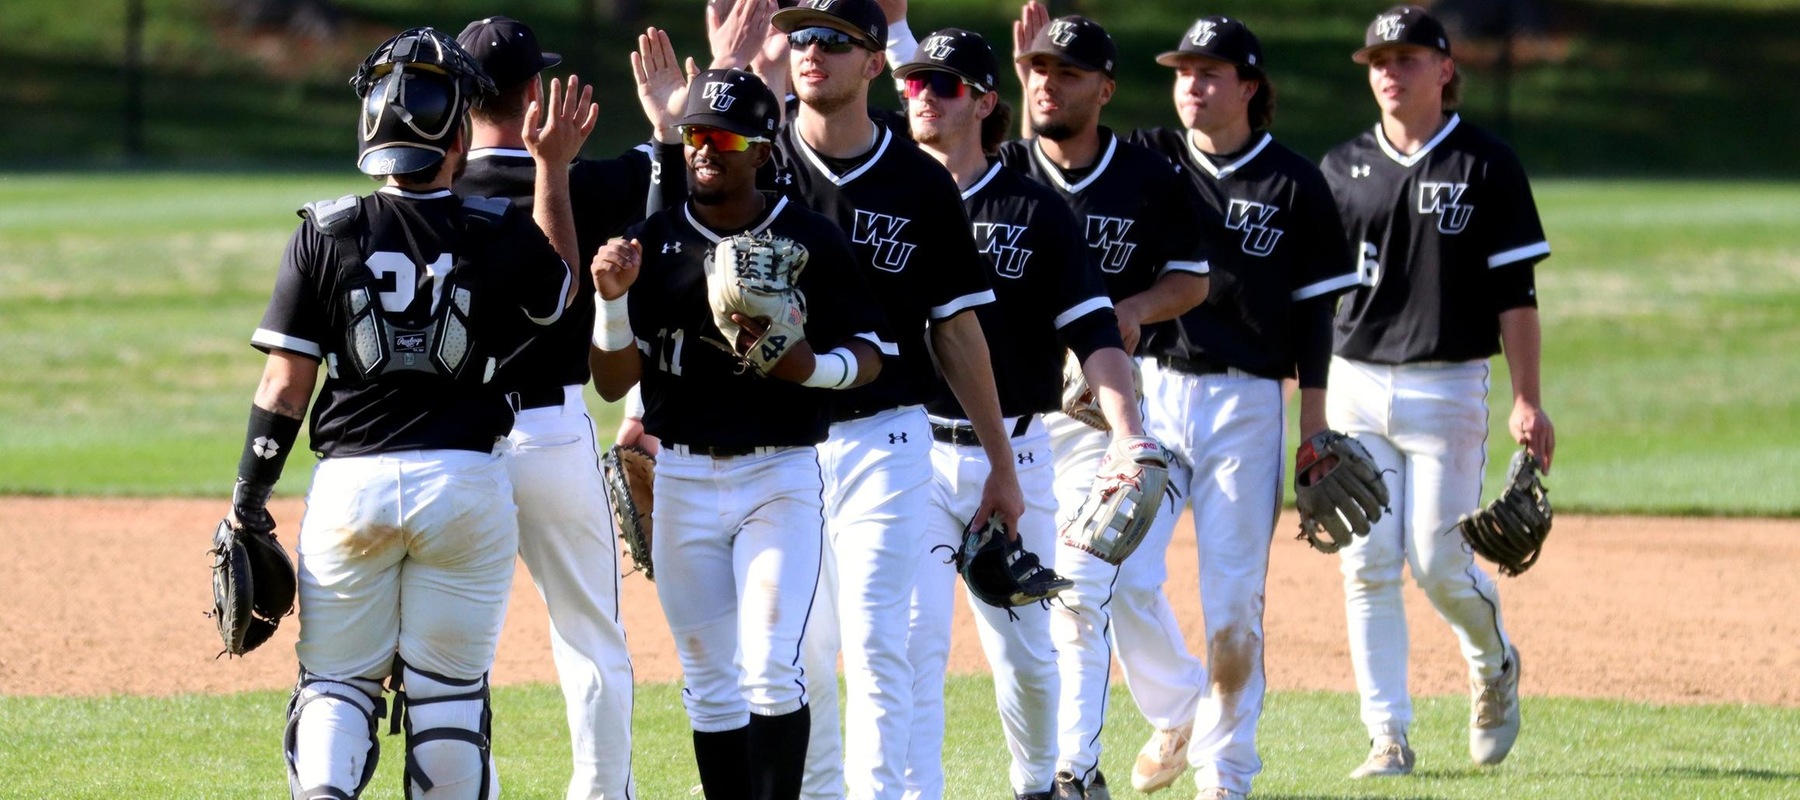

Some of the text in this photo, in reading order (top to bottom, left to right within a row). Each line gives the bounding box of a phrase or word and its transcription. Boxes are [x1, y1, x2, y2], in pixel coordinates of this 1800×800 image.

[1048, 18, 1078, 47] WU
[1189, 19, 1217, 46] WU
[1376, 14, 1405, 41] WU
[924, 35, 955, 60] WU
[702, 82, 736, 112] WU
[380, 158, 396, 175] 21
[1418, 182, 1474, 234] WU
[852, 208, 917, 273] WU
[1225, 198, 1284, 257] WU
[973, 222, 1033, 279] WU
[1086, 215, 1136, 273] WU
[657, 328, 684, 376] 11
[761, 335, 788, 362] 44
